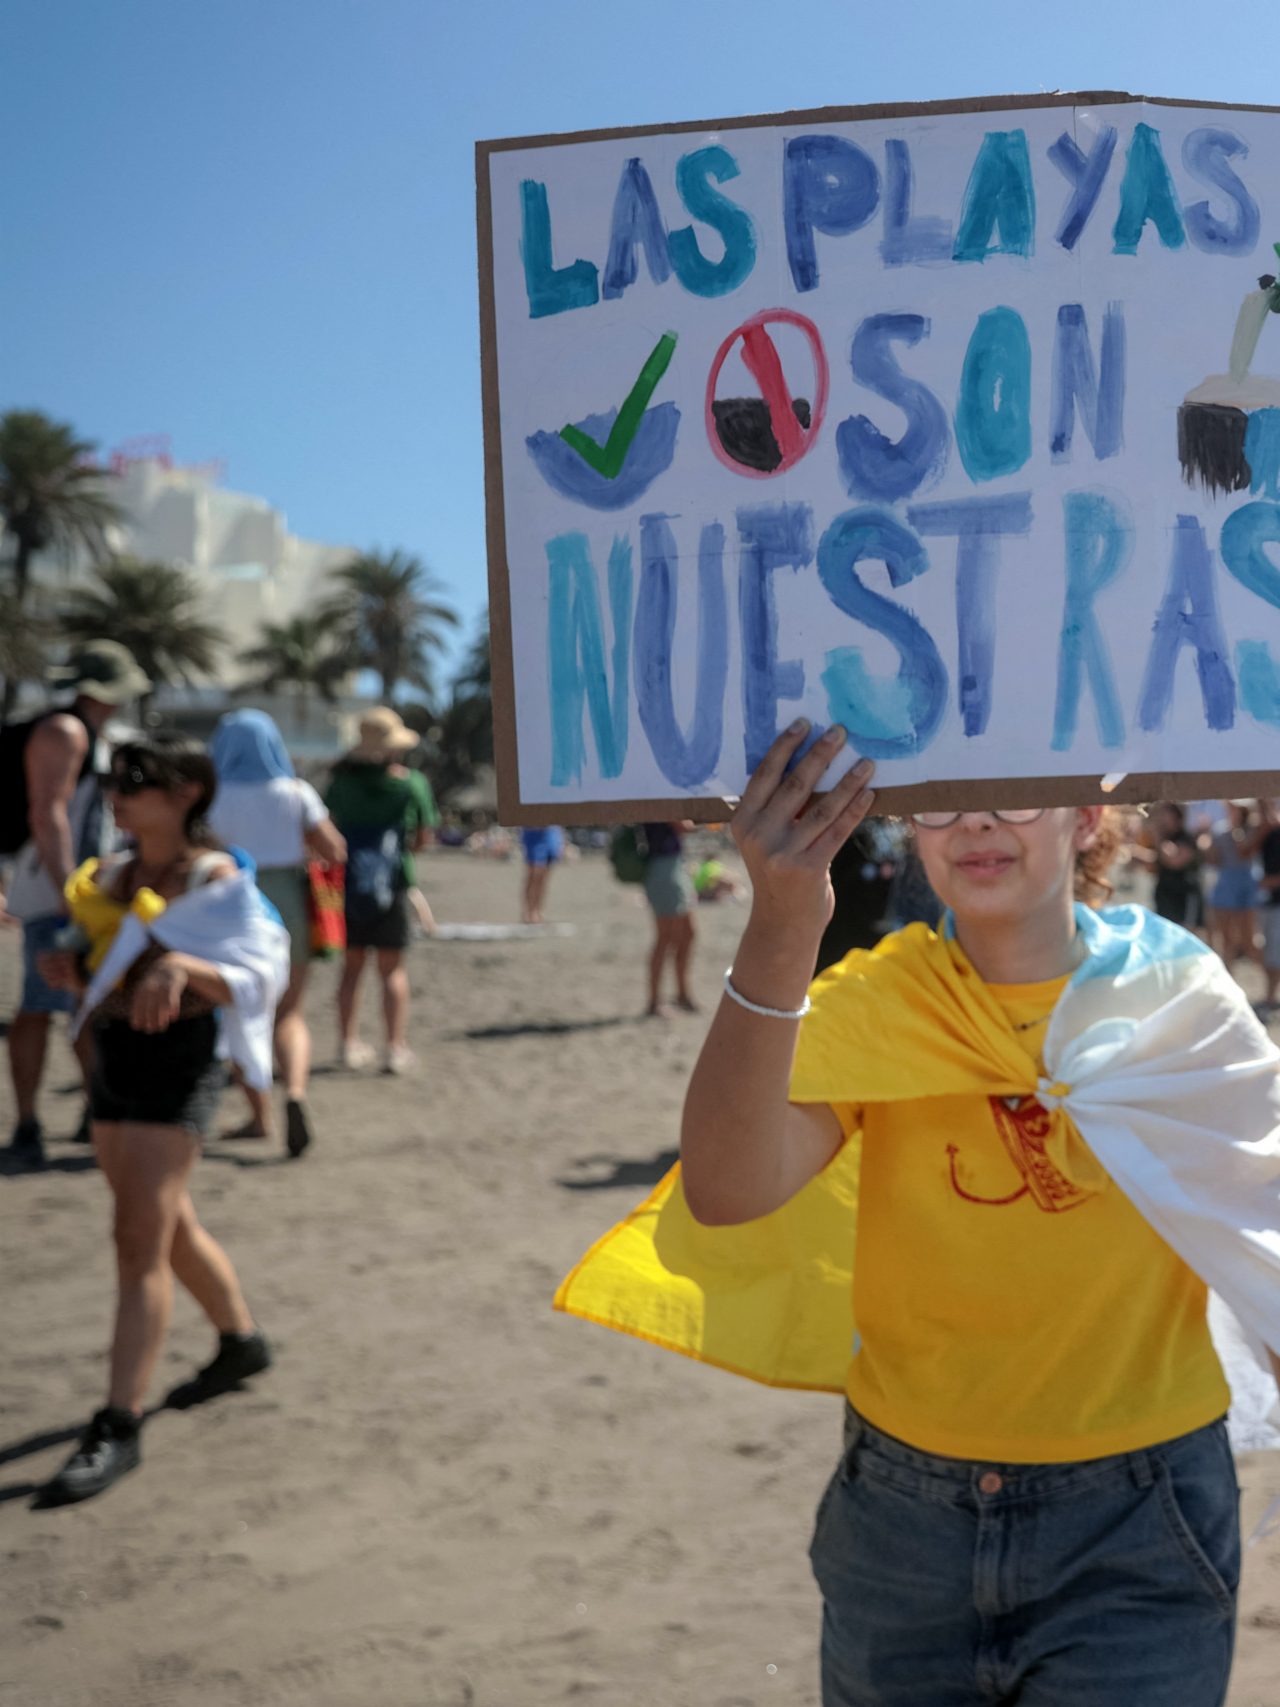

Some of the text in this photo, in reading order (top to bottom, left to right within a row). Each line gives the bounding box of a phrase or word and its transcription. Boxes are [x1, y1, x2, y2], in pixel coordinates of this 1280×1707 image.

[519, 123, 1260, 317] LAS PLAYAS
[836, 301, 1126, 501] SON
